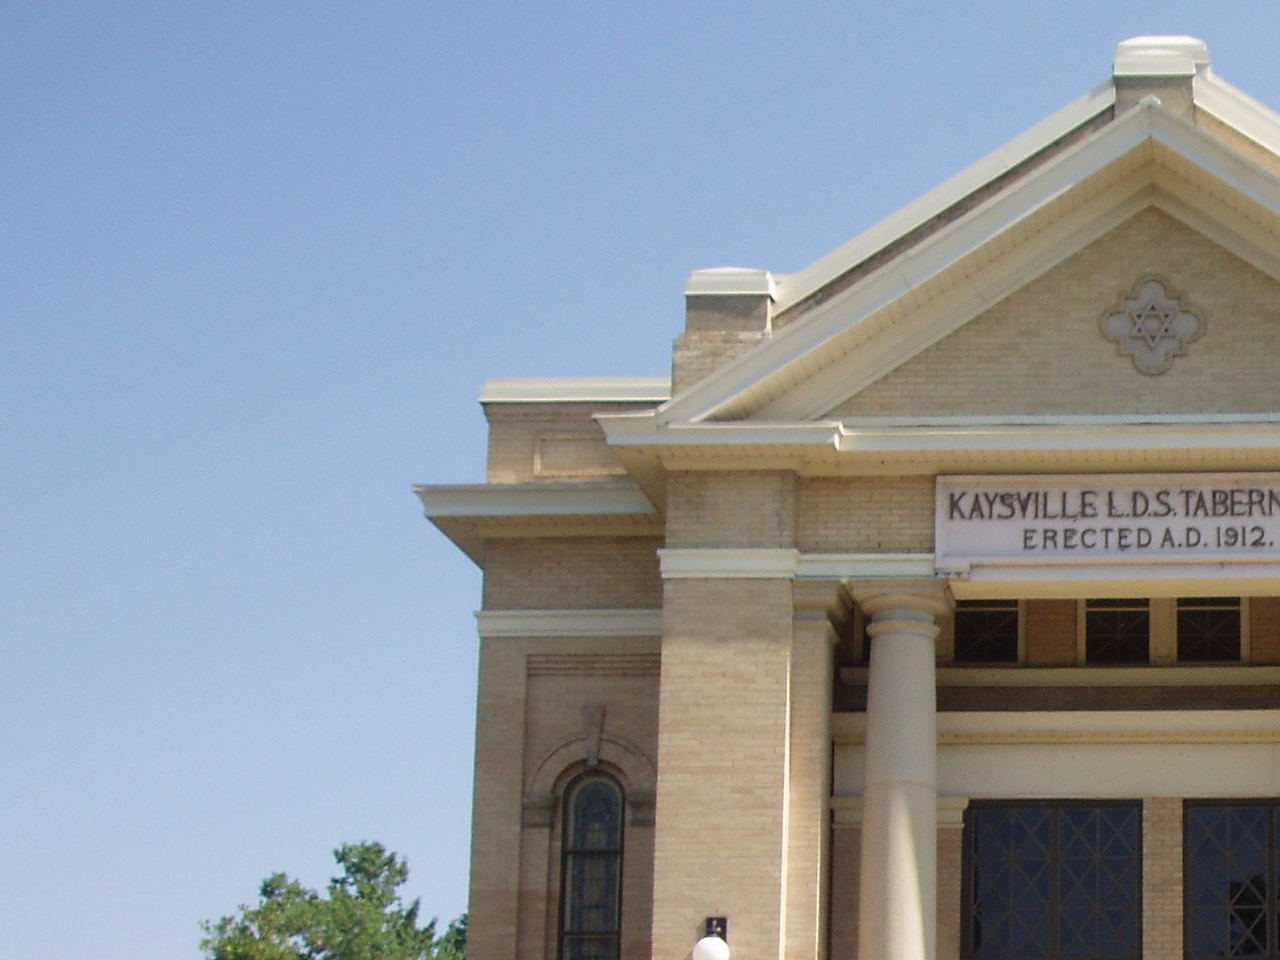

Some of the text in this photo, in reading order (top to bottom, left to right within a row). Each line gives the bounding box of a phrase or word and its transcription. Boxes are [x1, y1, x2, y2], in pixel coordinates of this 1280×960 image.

[949, 489, 1099, 520] KAYSVILLE
[1023, 525, 1274, 550] ERECTED A.D. 1912.
